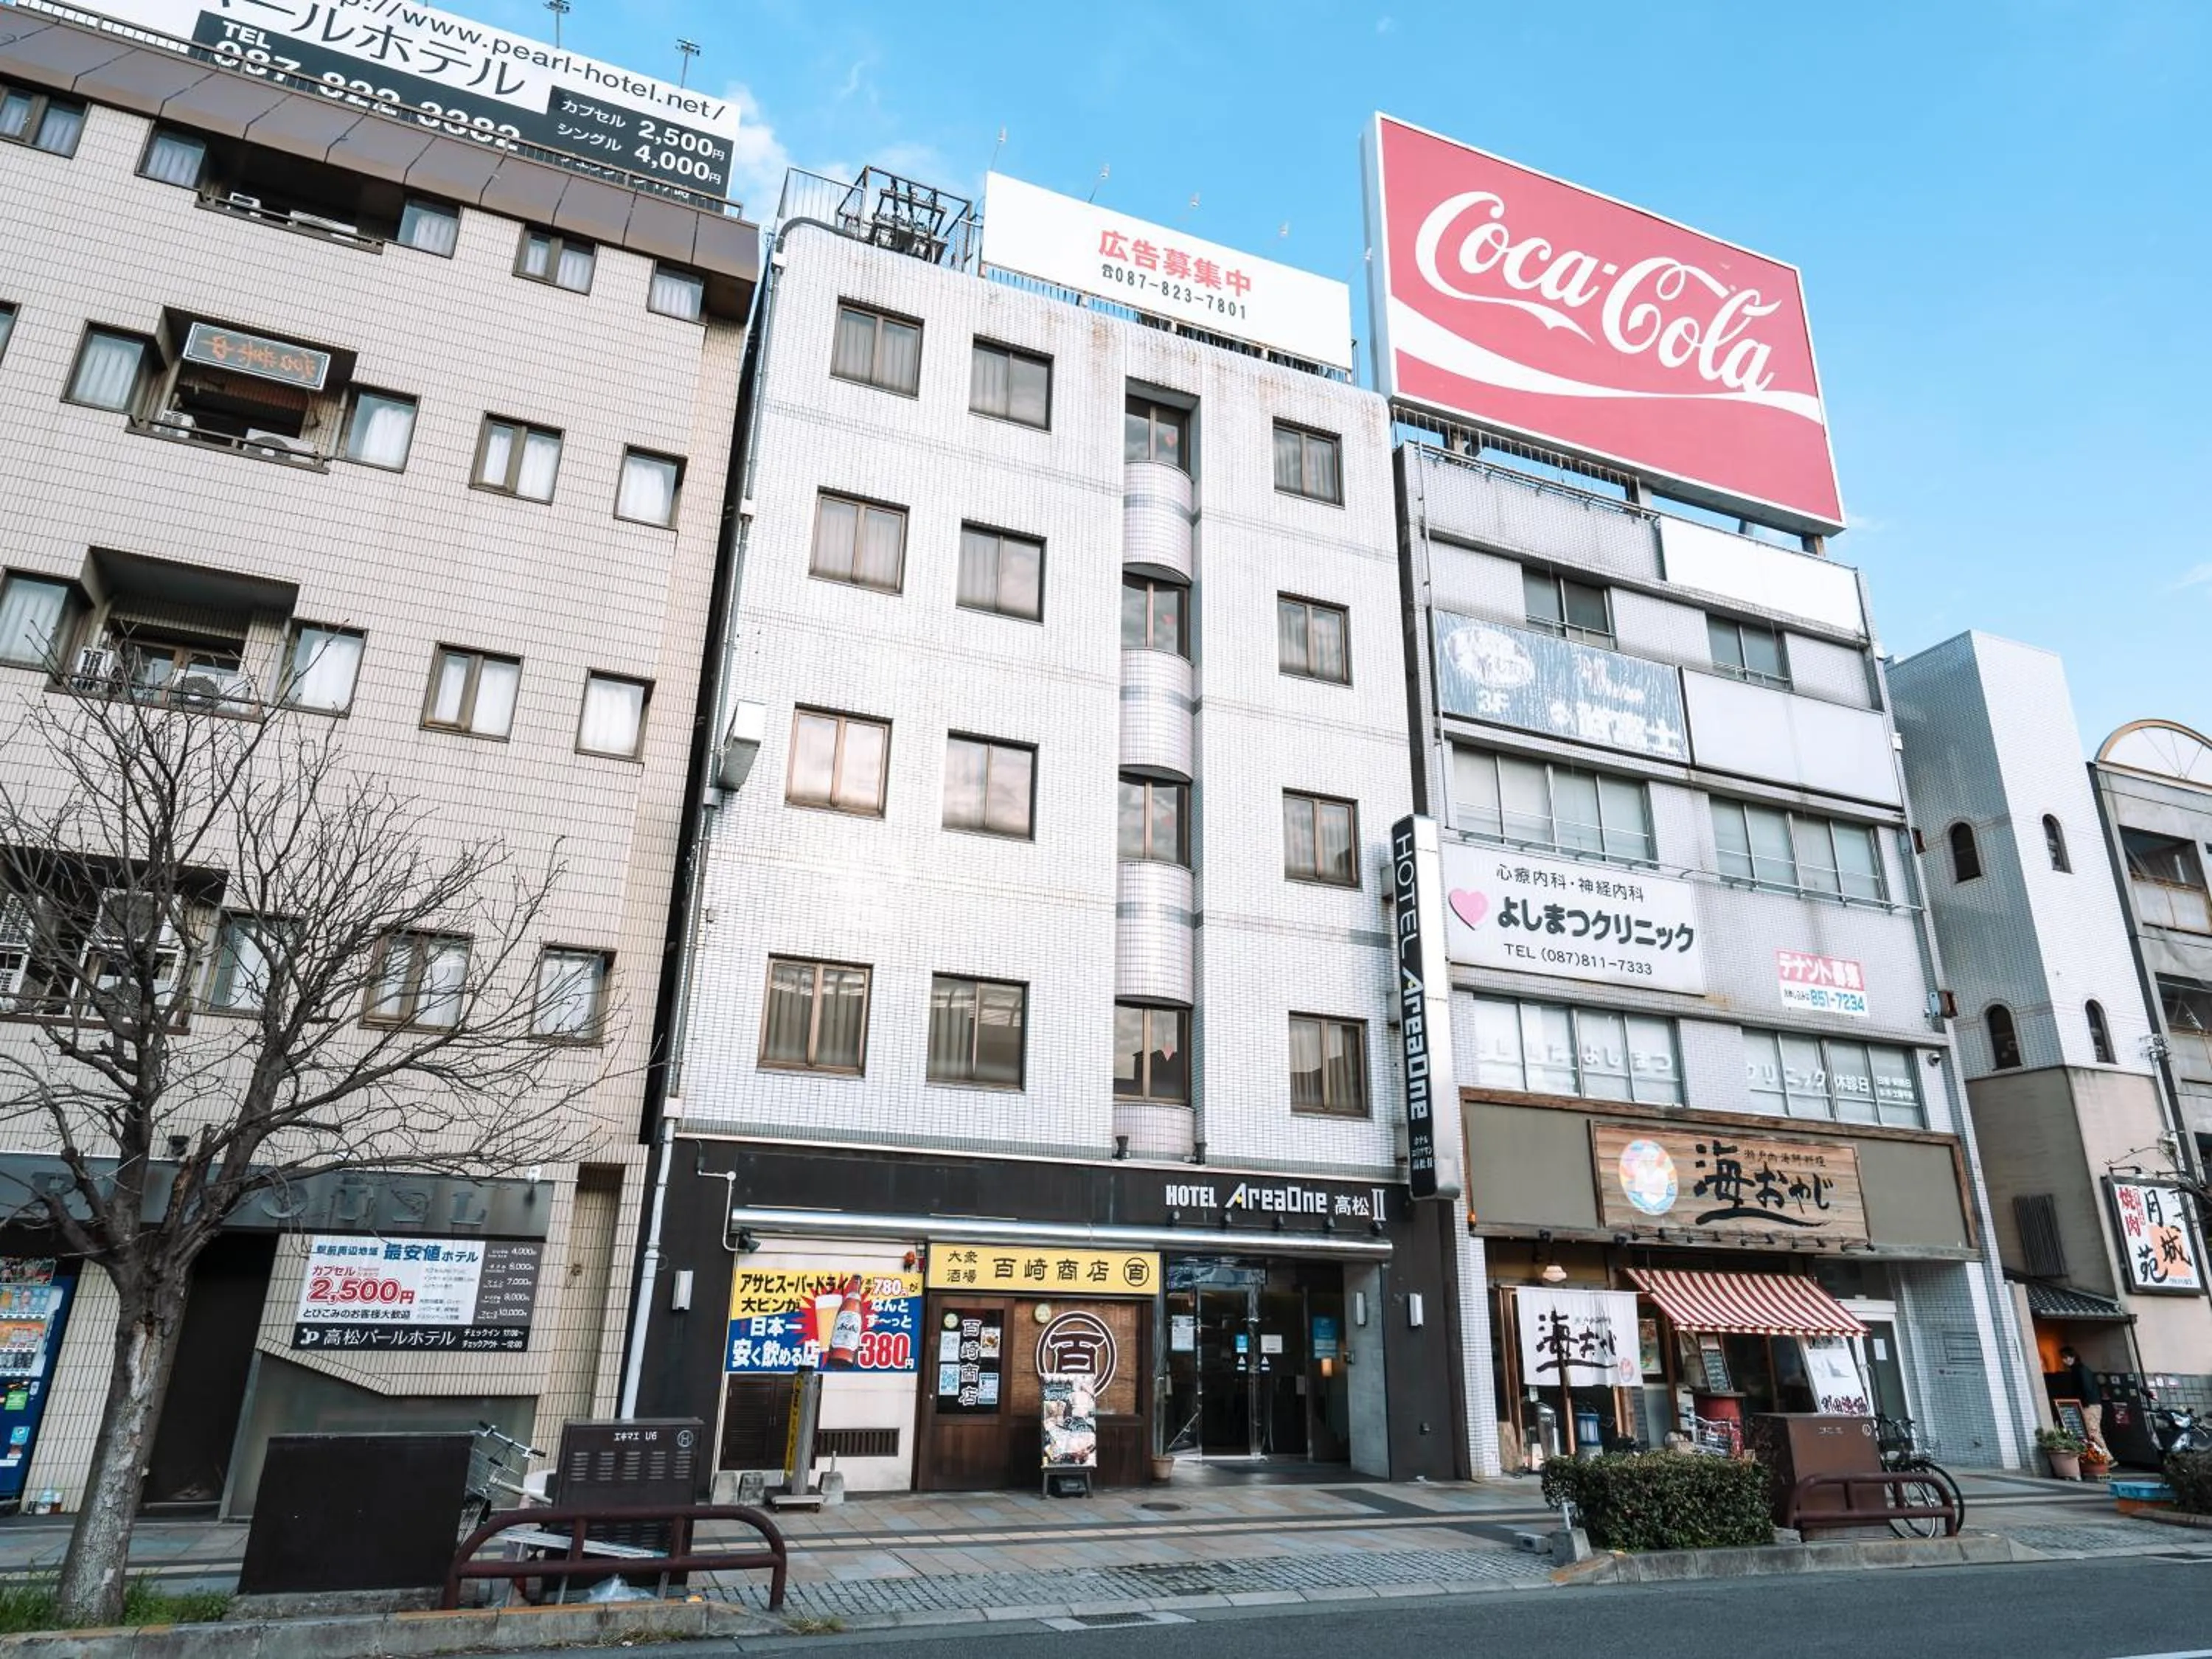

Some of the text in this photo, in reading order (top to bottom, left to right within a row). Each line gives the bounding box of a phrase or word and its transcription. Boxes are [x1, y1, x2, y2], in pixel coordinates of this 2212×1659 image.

[223, 21, 271, 49] TEL
[223, 0, 525, 94] ールホテル
[560, 99, 725, 161] カプセル 2,500円
[557, 122, 622, 152] シングル
[634, 145, 722, 185] 4,000円
[1099, 229, 1252, 298] 広告募集中
[1416, 191, 1782, 394] Coca-Cola
[1394, 833, 1417, 959] HOTEL
[1498, 896, 1694, 953] よしまつクリニック
[1503, 942, 1536, 959] TEL
[1166, 1184, 1217, 1208] HOTEL
[312, 1265, 355, 1276] カプセル
[947, 1251, 978, 1264] 大衆
[307, 1276, 415, 1305] 2,500円
[947, 1269, 978, 1284] 酒場
[741, 1297, 801, 1312] 大ビンが
[872, 1298, 909, 1313] なんと
[324, 1329, 456, 1346] 高松パールホテル
[751, 1316, 803, 1337] 日本一
[732, 1338, 821, 1368] 安く飲める店
[858, 1332, 914, 1369] 380円
